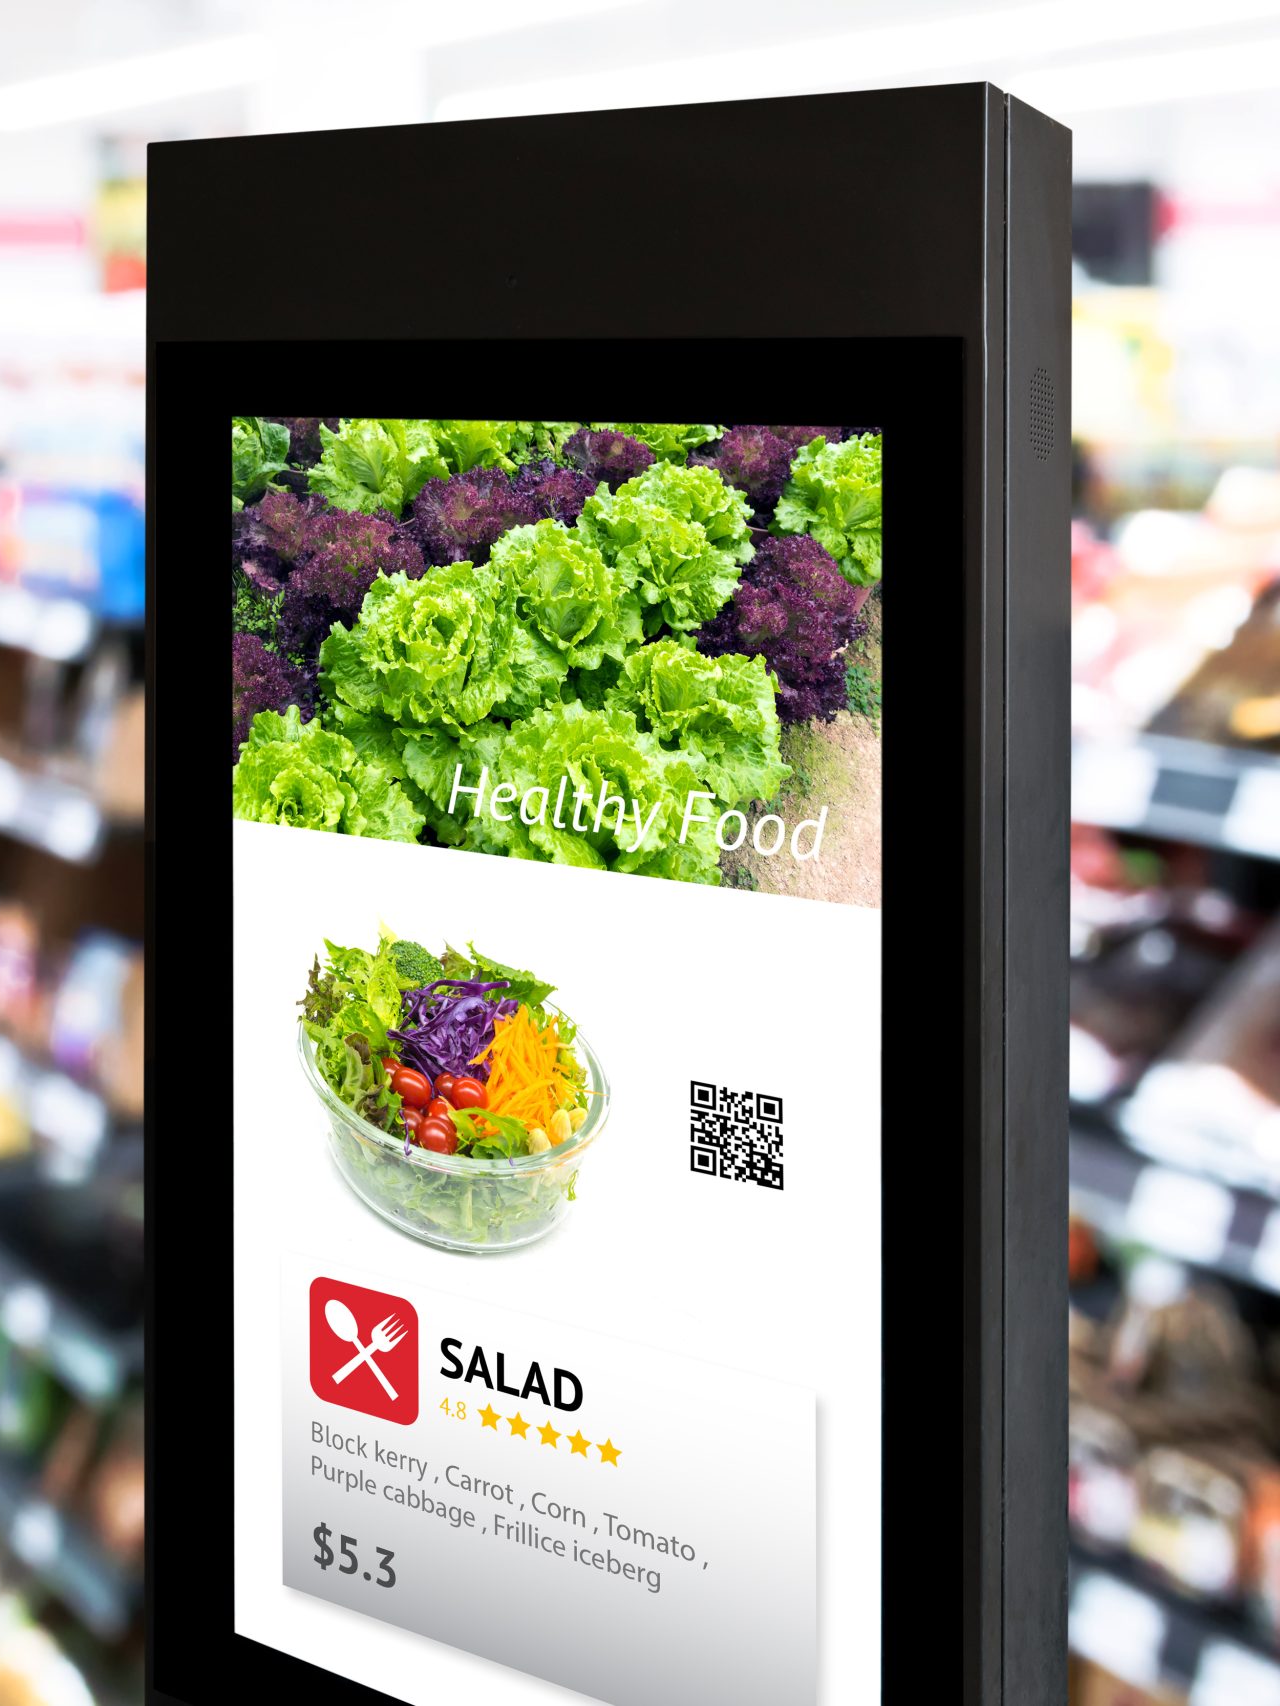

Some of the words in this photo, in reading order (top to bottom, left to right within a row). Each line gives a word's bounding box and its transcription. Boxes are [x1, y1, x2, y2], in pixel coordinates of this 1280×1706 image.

[447, 763, 661, 853] Healthy
[678, 790, 830, 863] Food
[439, 1337, 584, 1413] SALAD
[439, 1397, 467, 1420] 4.8
[311, 1420, 368, 1459] Block
[374, 1439, 428, 1482] kerry
[445, 1464, 514, 1505] Carrot
[531, 1491, 586, 1529] Corn
[602, 1512, 696, 1562] Tomato
[311, 1454, 377, 1496] Purple
[382, 1484, 476, 1529] cabbage
[494, 1513, 566, 1558] Frillice
[573, 1539, 661, 1594] iceberg
[312, 1521, 397, 1589] $5.3
